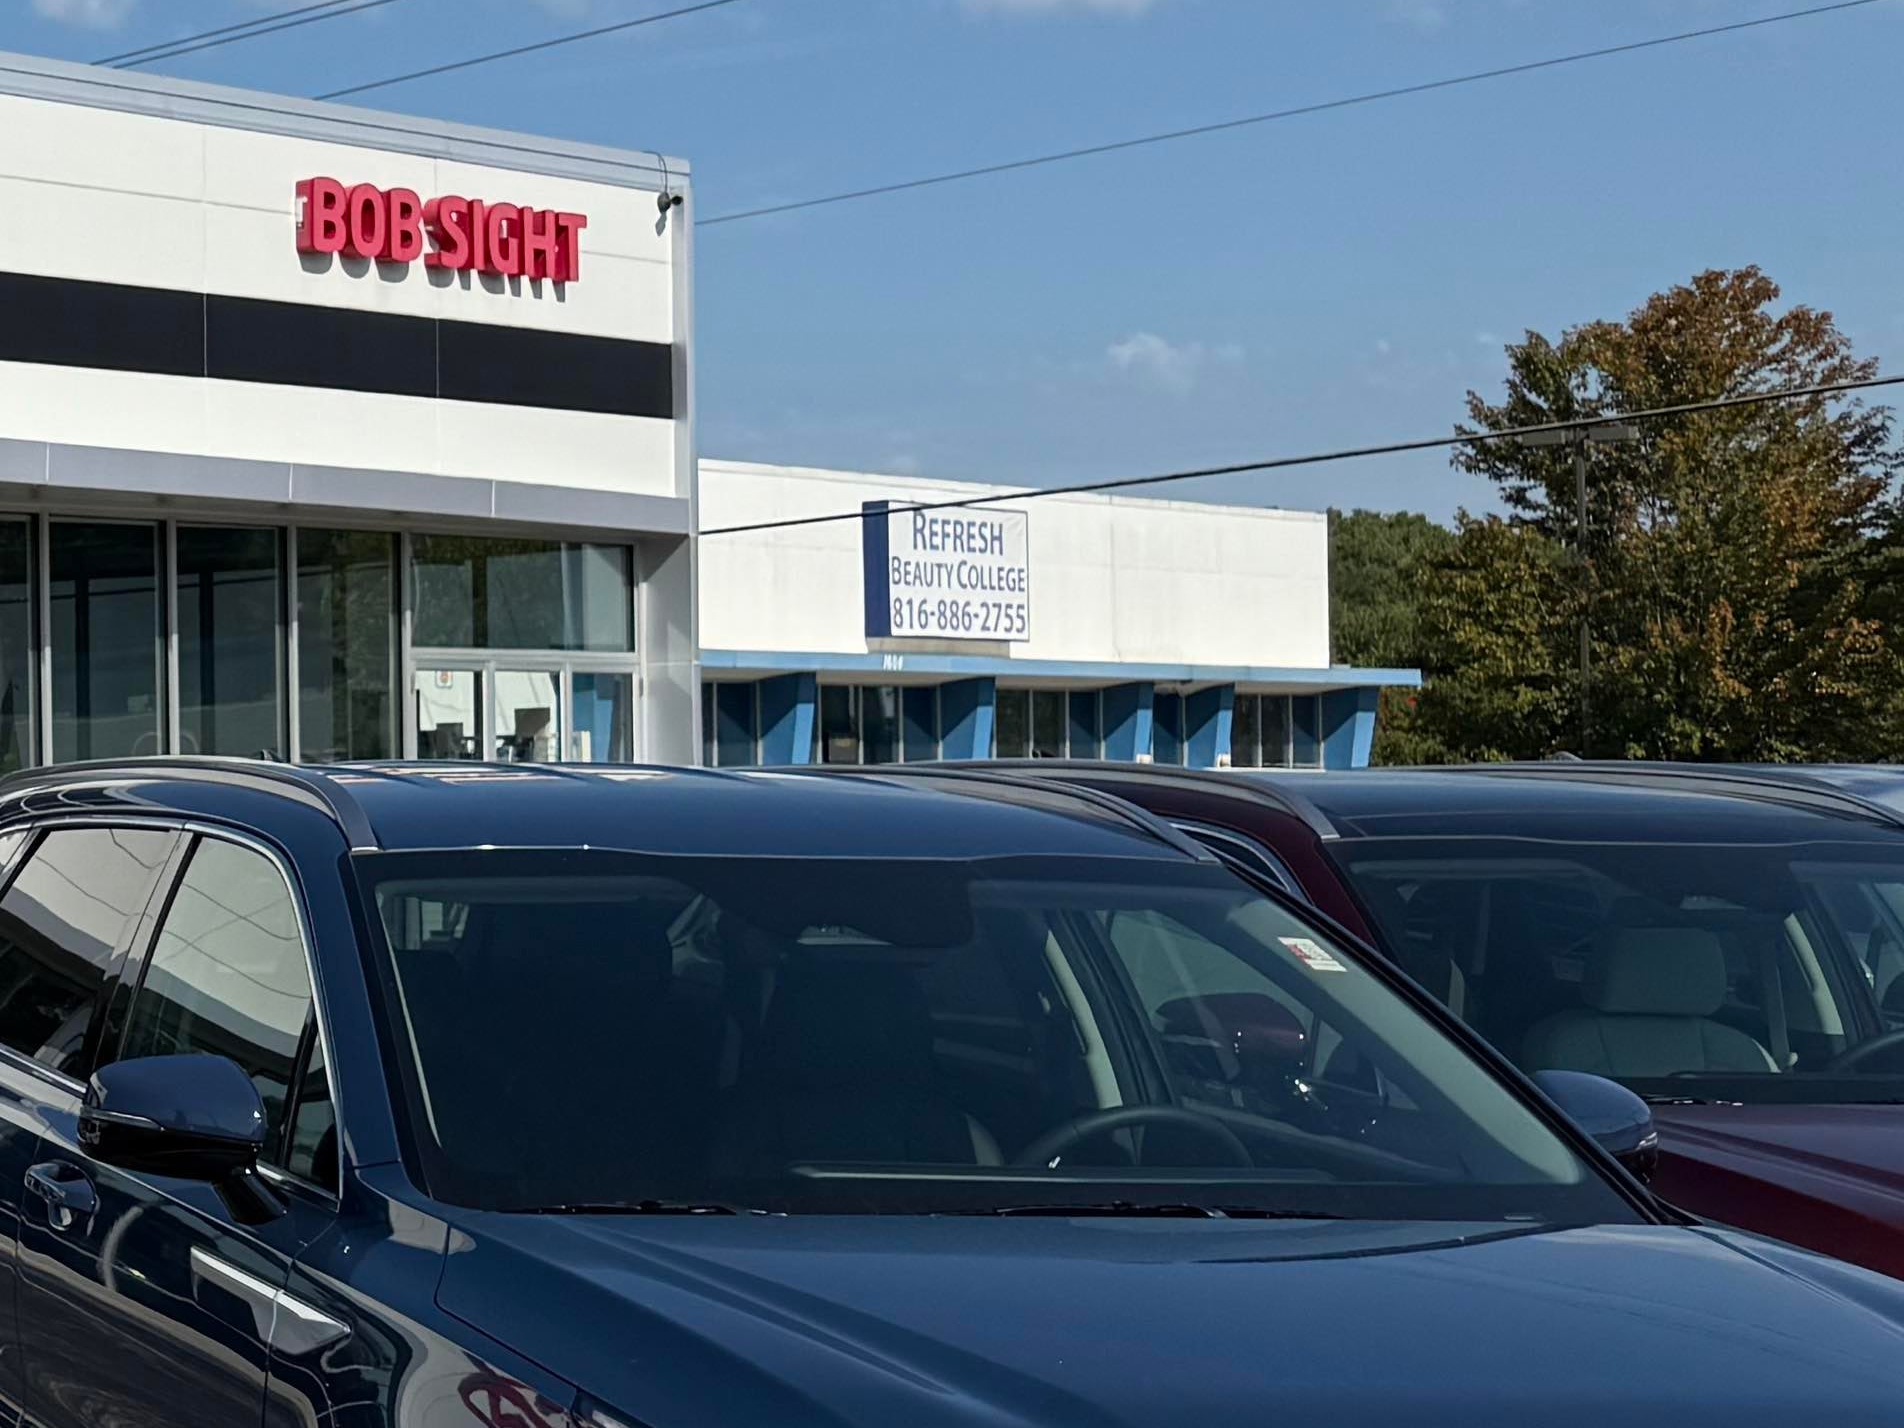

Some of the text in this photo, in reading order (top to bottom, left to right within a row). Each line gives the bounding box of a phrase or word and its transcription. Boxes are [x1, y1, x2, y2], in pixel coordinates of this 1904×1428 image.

[296, 176, 588, 283] BOB SIGHT
[912, 508, 1004, 556] REFRESH
[891, 555, 1026, 592] BEAUTY COLLEGE
[892, 596, 1026, 634] 816-886-2755
